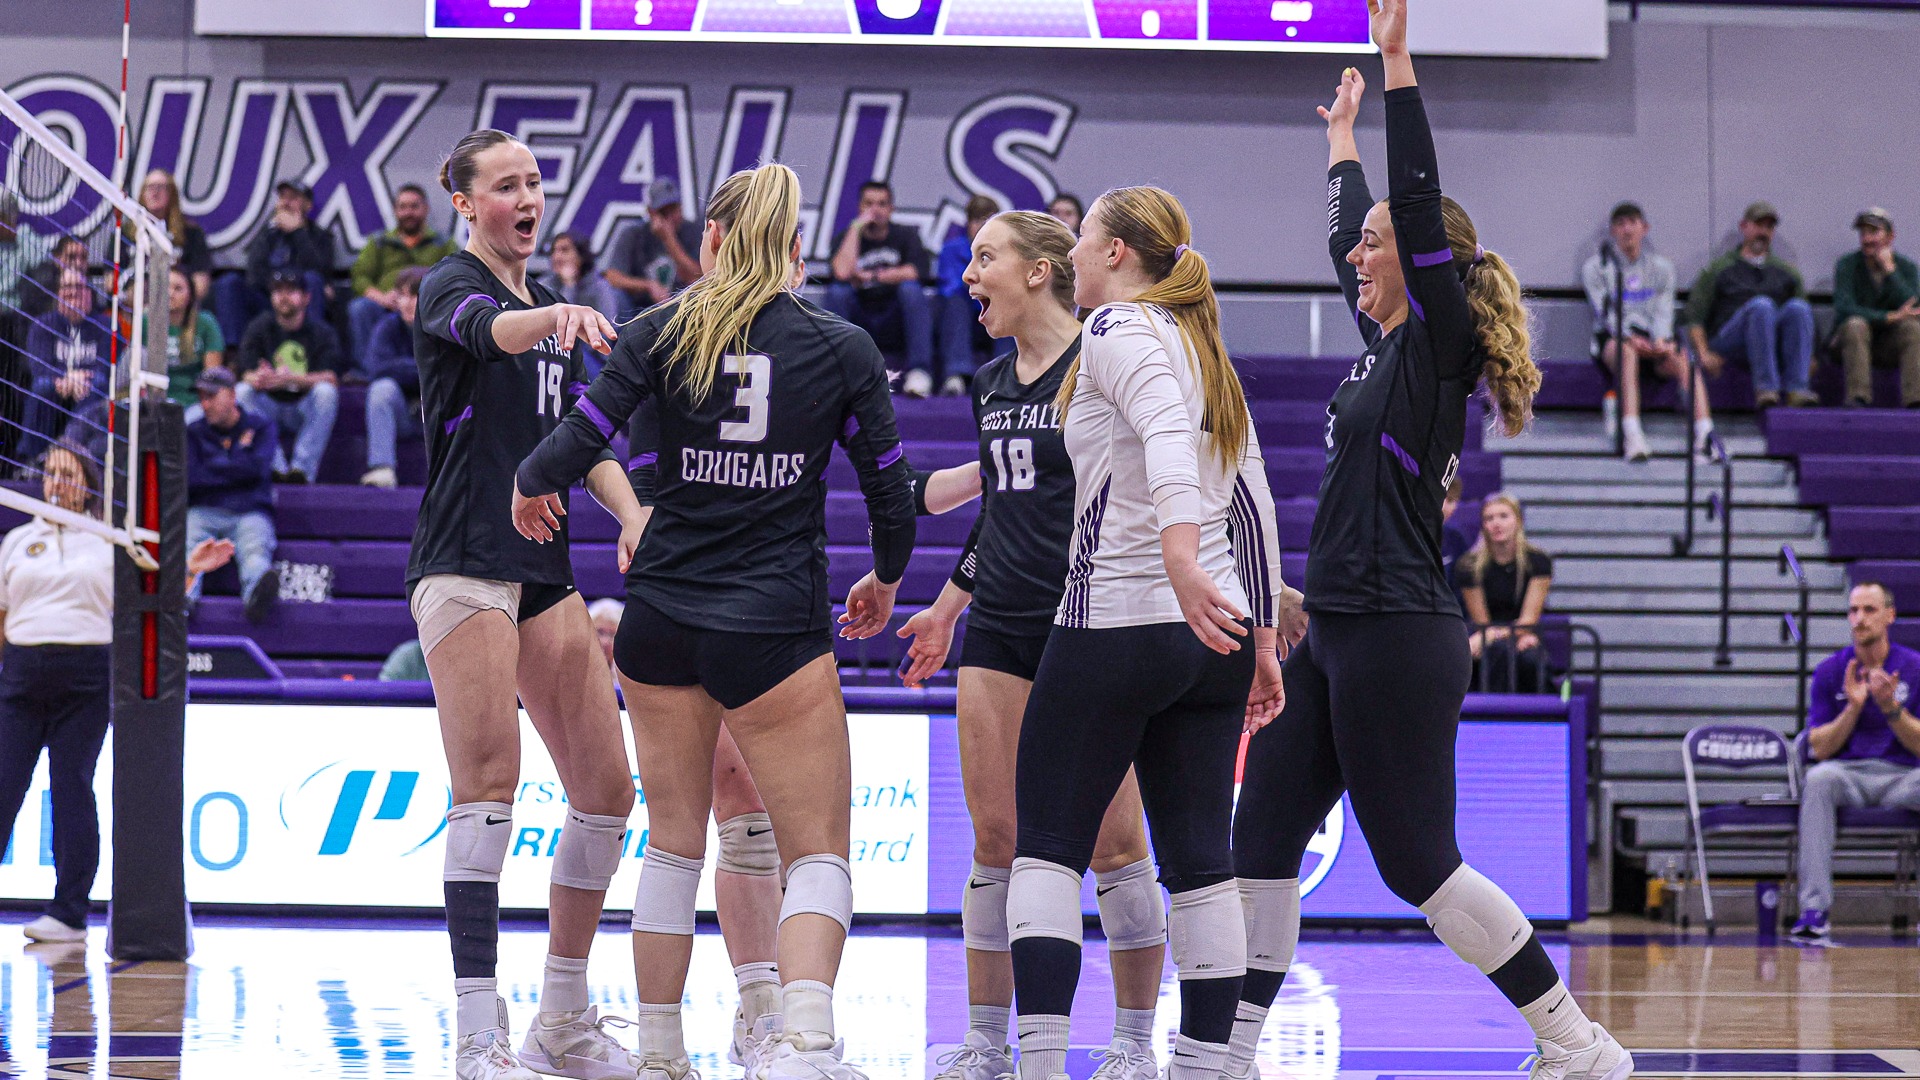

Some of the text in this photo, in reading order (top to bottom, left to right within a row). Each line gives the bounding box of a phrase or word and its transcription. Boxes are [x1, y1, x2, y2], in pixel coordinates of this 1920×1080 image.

[537, 360, 564, 418] 19
[719, 353, 772, 442] 3
[1017, 404, 1061, 430] FALL
[681, 447, 805, 489] COUGARS
[990, 438, 1036, 491] 18
[1697, 739, 1779, 760] COUGARS
[851, 778, 920, 808] ank
